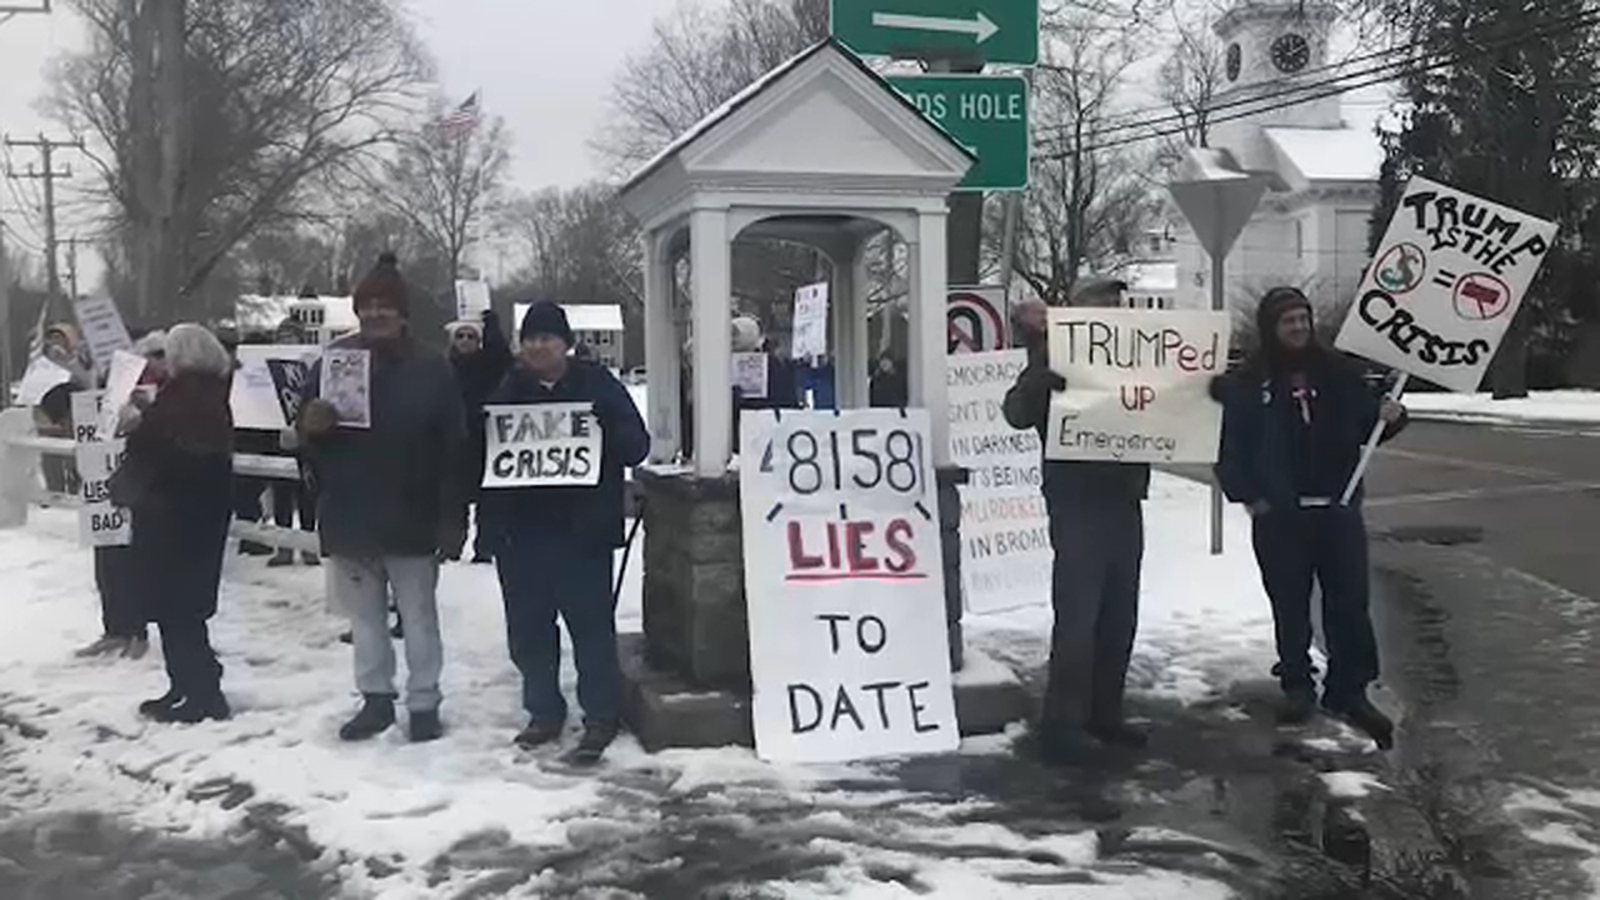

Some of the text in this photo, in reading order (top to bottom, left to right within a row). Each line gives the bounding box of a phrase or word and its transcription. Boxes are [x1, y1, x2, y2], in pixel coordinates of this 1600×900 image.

[960, 93, 1022, 120] HOLE
[1403, 191, 1547, 257] TRUMP
[1358, 289, 1490, 366] CRISIS
[1056, 321, 1219, 372] TRUMPed
[946, 361, 1025, 386] EMOCRACY
[1120, 385, 1156, 411] UP
[495, 409, 591, 444] FAKE
[1059, 414, 1176, 461] Emergency
[492, 446, 591, 478] CRISIS
[992, 465, 1041, 488] BEING
[91, 513, 123, 532] BAD
[786, 518, 917, 572] LIES
[969, 534, 992, 559] IN
[815, 615, 887, 655] TO
[787, 682, 940, 734] DATE
